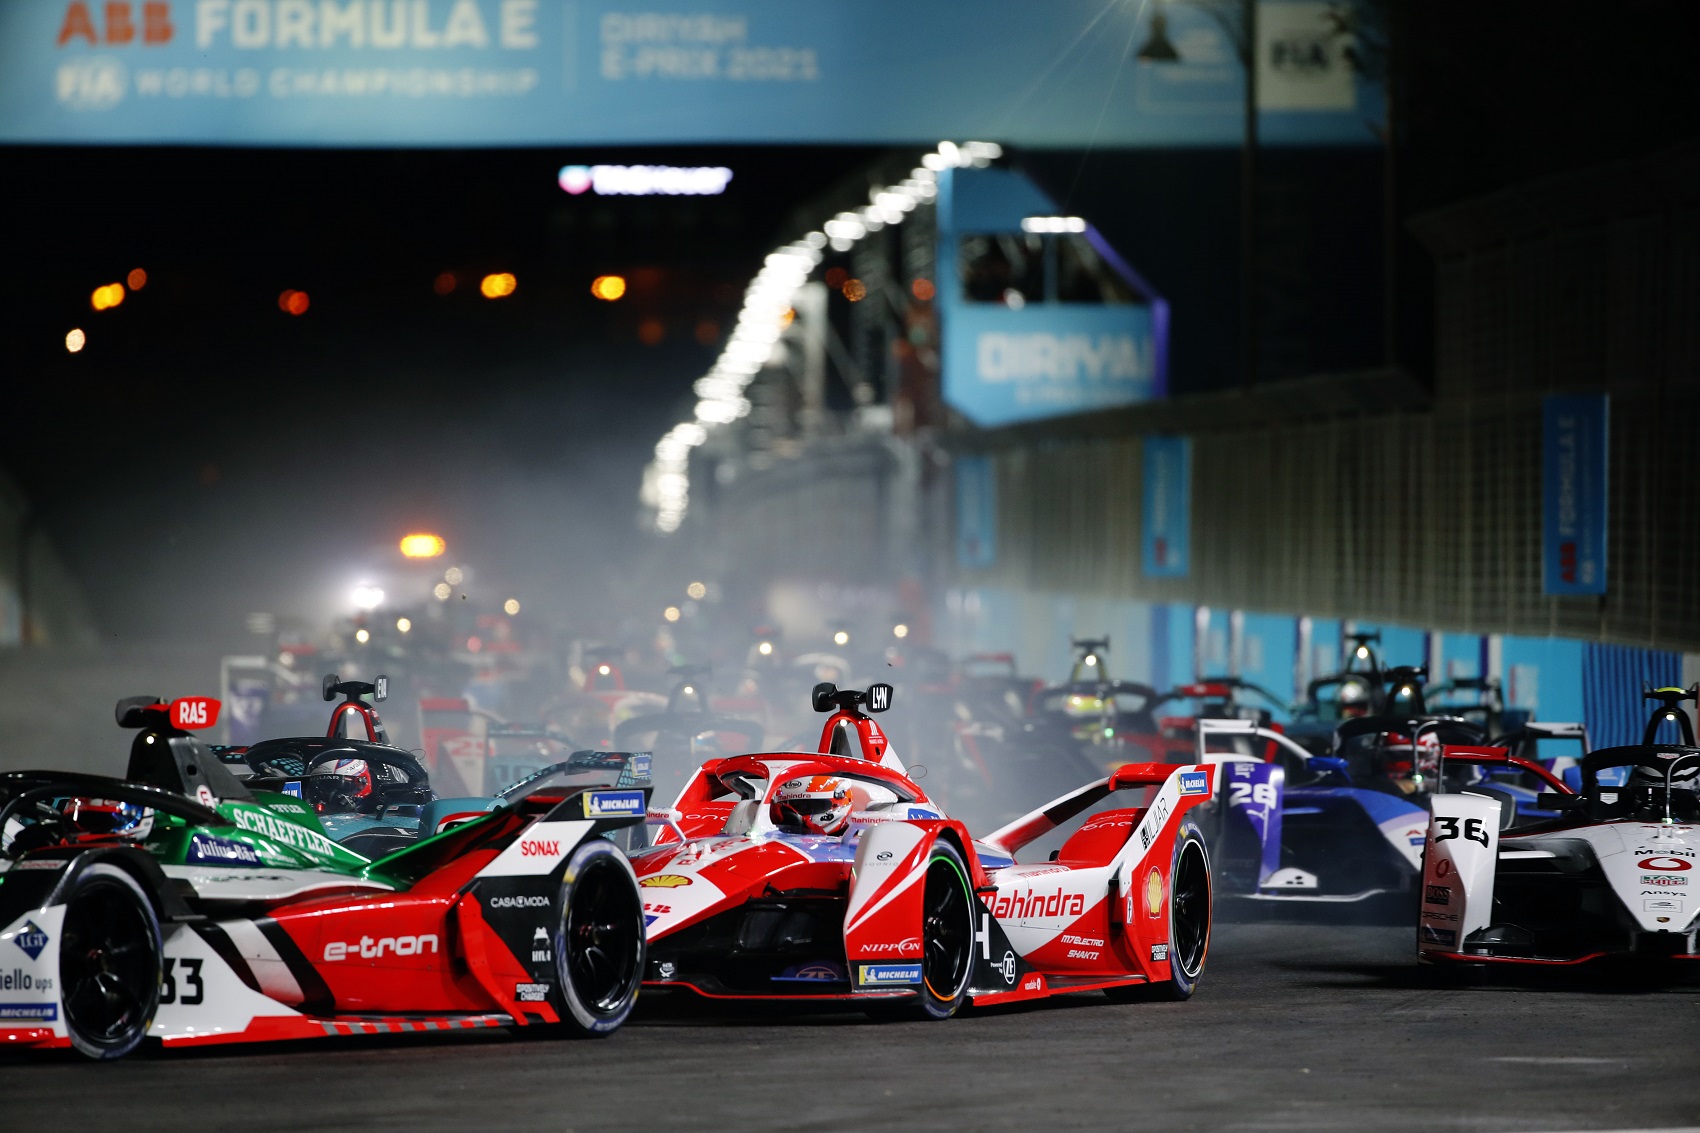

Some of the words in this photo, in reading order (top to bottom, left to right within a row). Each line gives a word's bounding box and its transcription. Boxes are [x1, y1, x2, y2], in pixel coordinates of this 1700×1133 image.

[55, 0, 174, 46] ABB
[194, 0, 489, 49] FORMULA
[500, 0, 540, 49] E
[602, 47, 717, 79] E-PRIX
[727, 47, 818, 80] 2021
[136, 67, 259, 98] WORLD
[267, 67, 539, 98] CHAMPIONSHIP
[872, 687, 887, 709] LYN
[179, 701, 208, 724] RAS
[600, 798, 640, 810] MICHELIN
[233, 808, 335, 857] SCHAEFFLER
[1434, 816, 1490, 848] 36
[196, 838, 236, 858] Julius
[233, 843, 258, 862] Bär
[521, 840, 560, 856] SONAX
[1634, 849, 1696, 857] Mobil
[1427, 885, 1450, 900] BOSS
[977, 887, 1085, 919] Mahindra
[20, 933, 46, 949] LGT
[324, 934, 439, 962] e-tron
[860, 938, 920, 954] NIPPON
[1067, 949, 1099, 960] SHAKTI
[877, 970, 919, 979] MICHELIN
[35, 978, 53, 994] ups
[0, 1008, 54, 1017] MICHELIN
